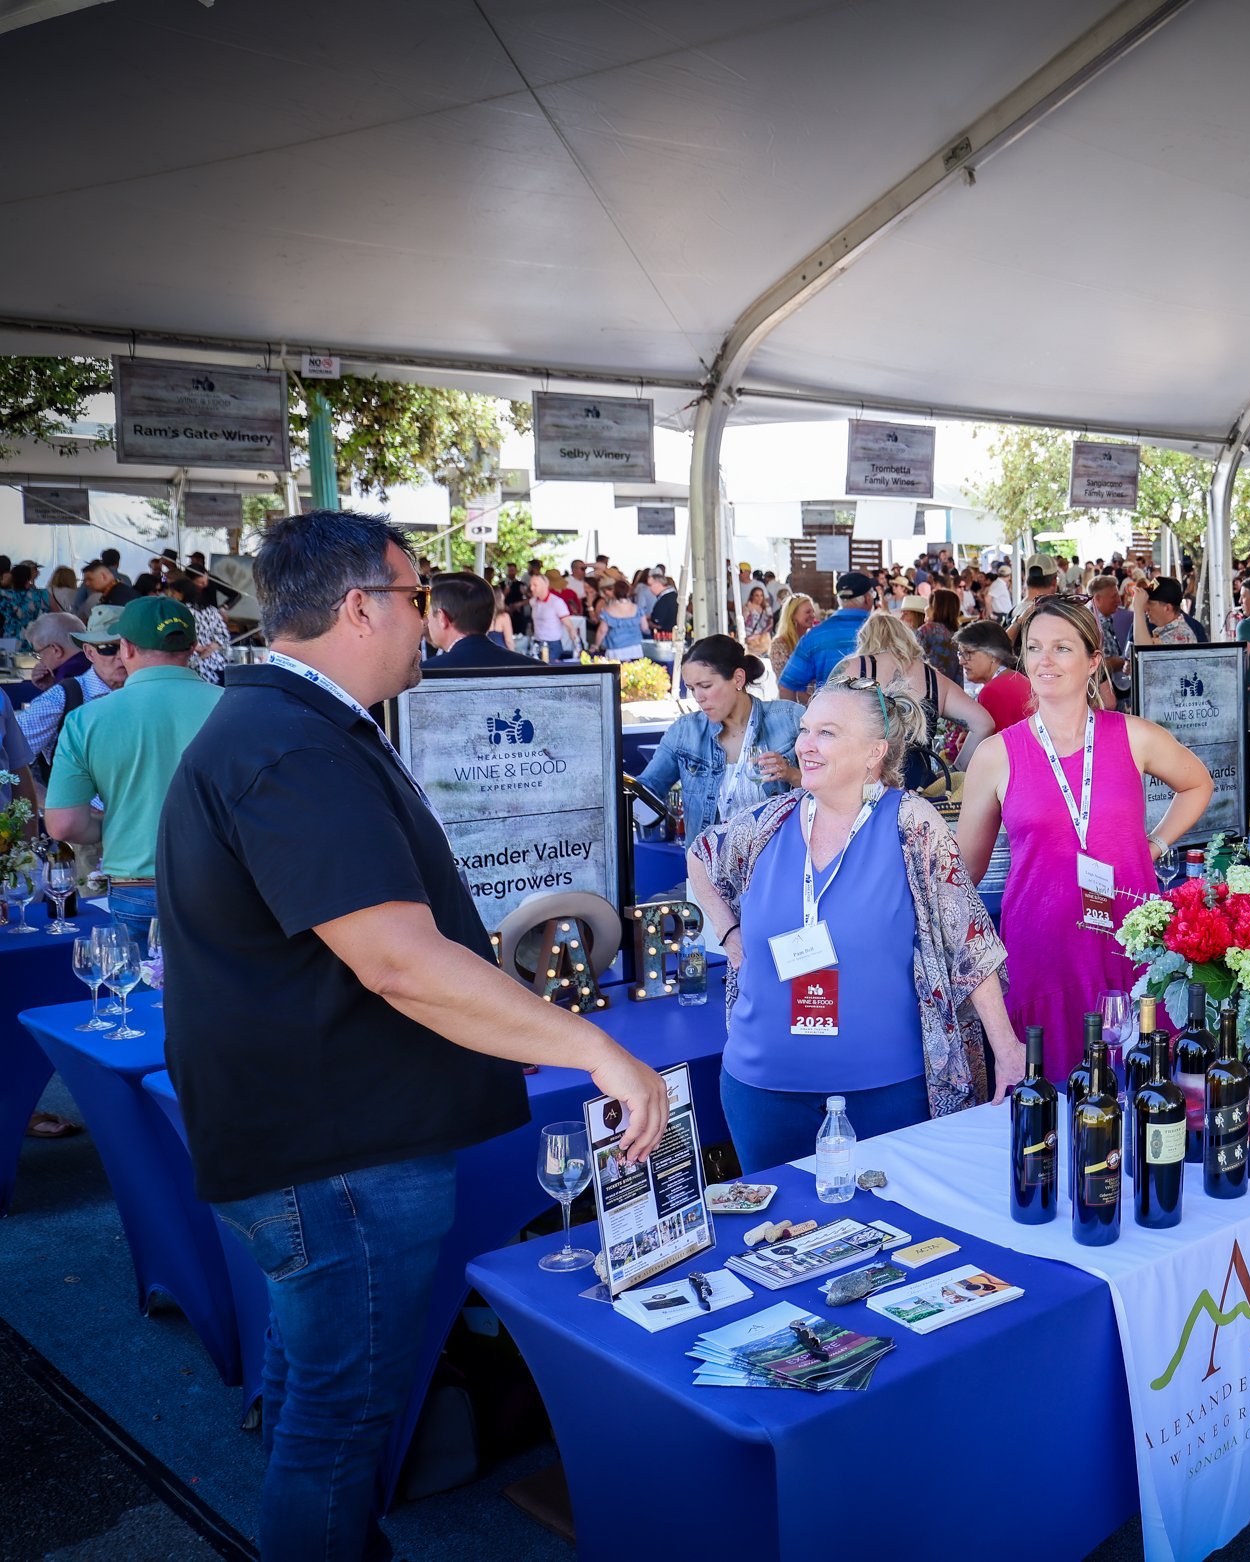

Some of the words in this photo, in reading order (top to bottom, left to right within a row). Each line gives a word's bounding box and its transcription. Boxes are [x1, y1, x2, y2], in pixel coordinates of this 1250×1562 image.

[309, 358, 321, 367] NO
[133, 424, 180, 439] Ram's
[183, 427, 219, 441] Gate
[221, 430, 274, 446] Winery
[559, 448, 591, 461] Selby
[593, 449, 631, 462] Winery
[871, 464, 911, 475] Trombetta
[864, 475, 890, 487] Family
[891, 477, 915, 486] Wines
[1084, 489, 1104, 498] Family
[1163, 710, 1187, 721] WINE
[1188, 709, 1195, 720] &
[1196, 707, 1220, 719] FOOD
[1176, 721, 1208, 730] EXPERIENCE
[453, 764, 501, 782] WINE
[504, 763, 516, 778] &
[520, 759, 567, 776] FOOD
[1209, 765, 1236, 779] yards
[480, 780, 544, 792] EXPERIENCE
[1148, 793, 1167, 802] Estate
[1219, 783, 1237, 792] Wines
[453, 846, 530, 870] exander
[534, 839, 593, 861] Valley
[470, 870, 573, 899] negrowers
[1086, 908, 1110, 920] 2023
[796, 1016, 834, 1027] 2023
[785, 1341, 841, 1364] EXPRE
[1188, 1435, 1239, 1480] SONOMA
